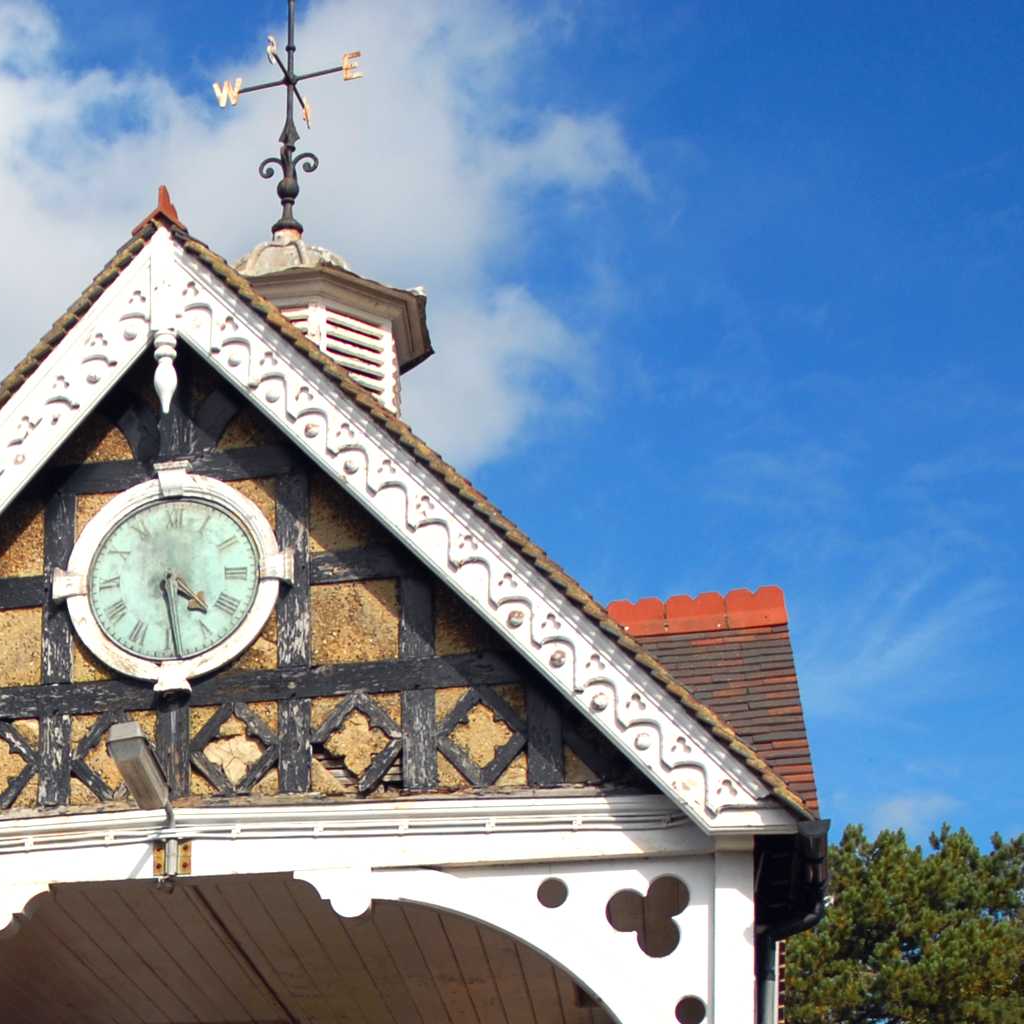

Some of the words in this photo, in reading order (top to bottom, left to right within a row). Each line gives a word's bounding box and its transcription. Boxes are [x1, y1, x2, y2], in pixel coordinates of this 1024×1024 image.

[342, 51, 364, 81] E
[212, 77, 243, 108] W
[224, 566, 248, 581] III
